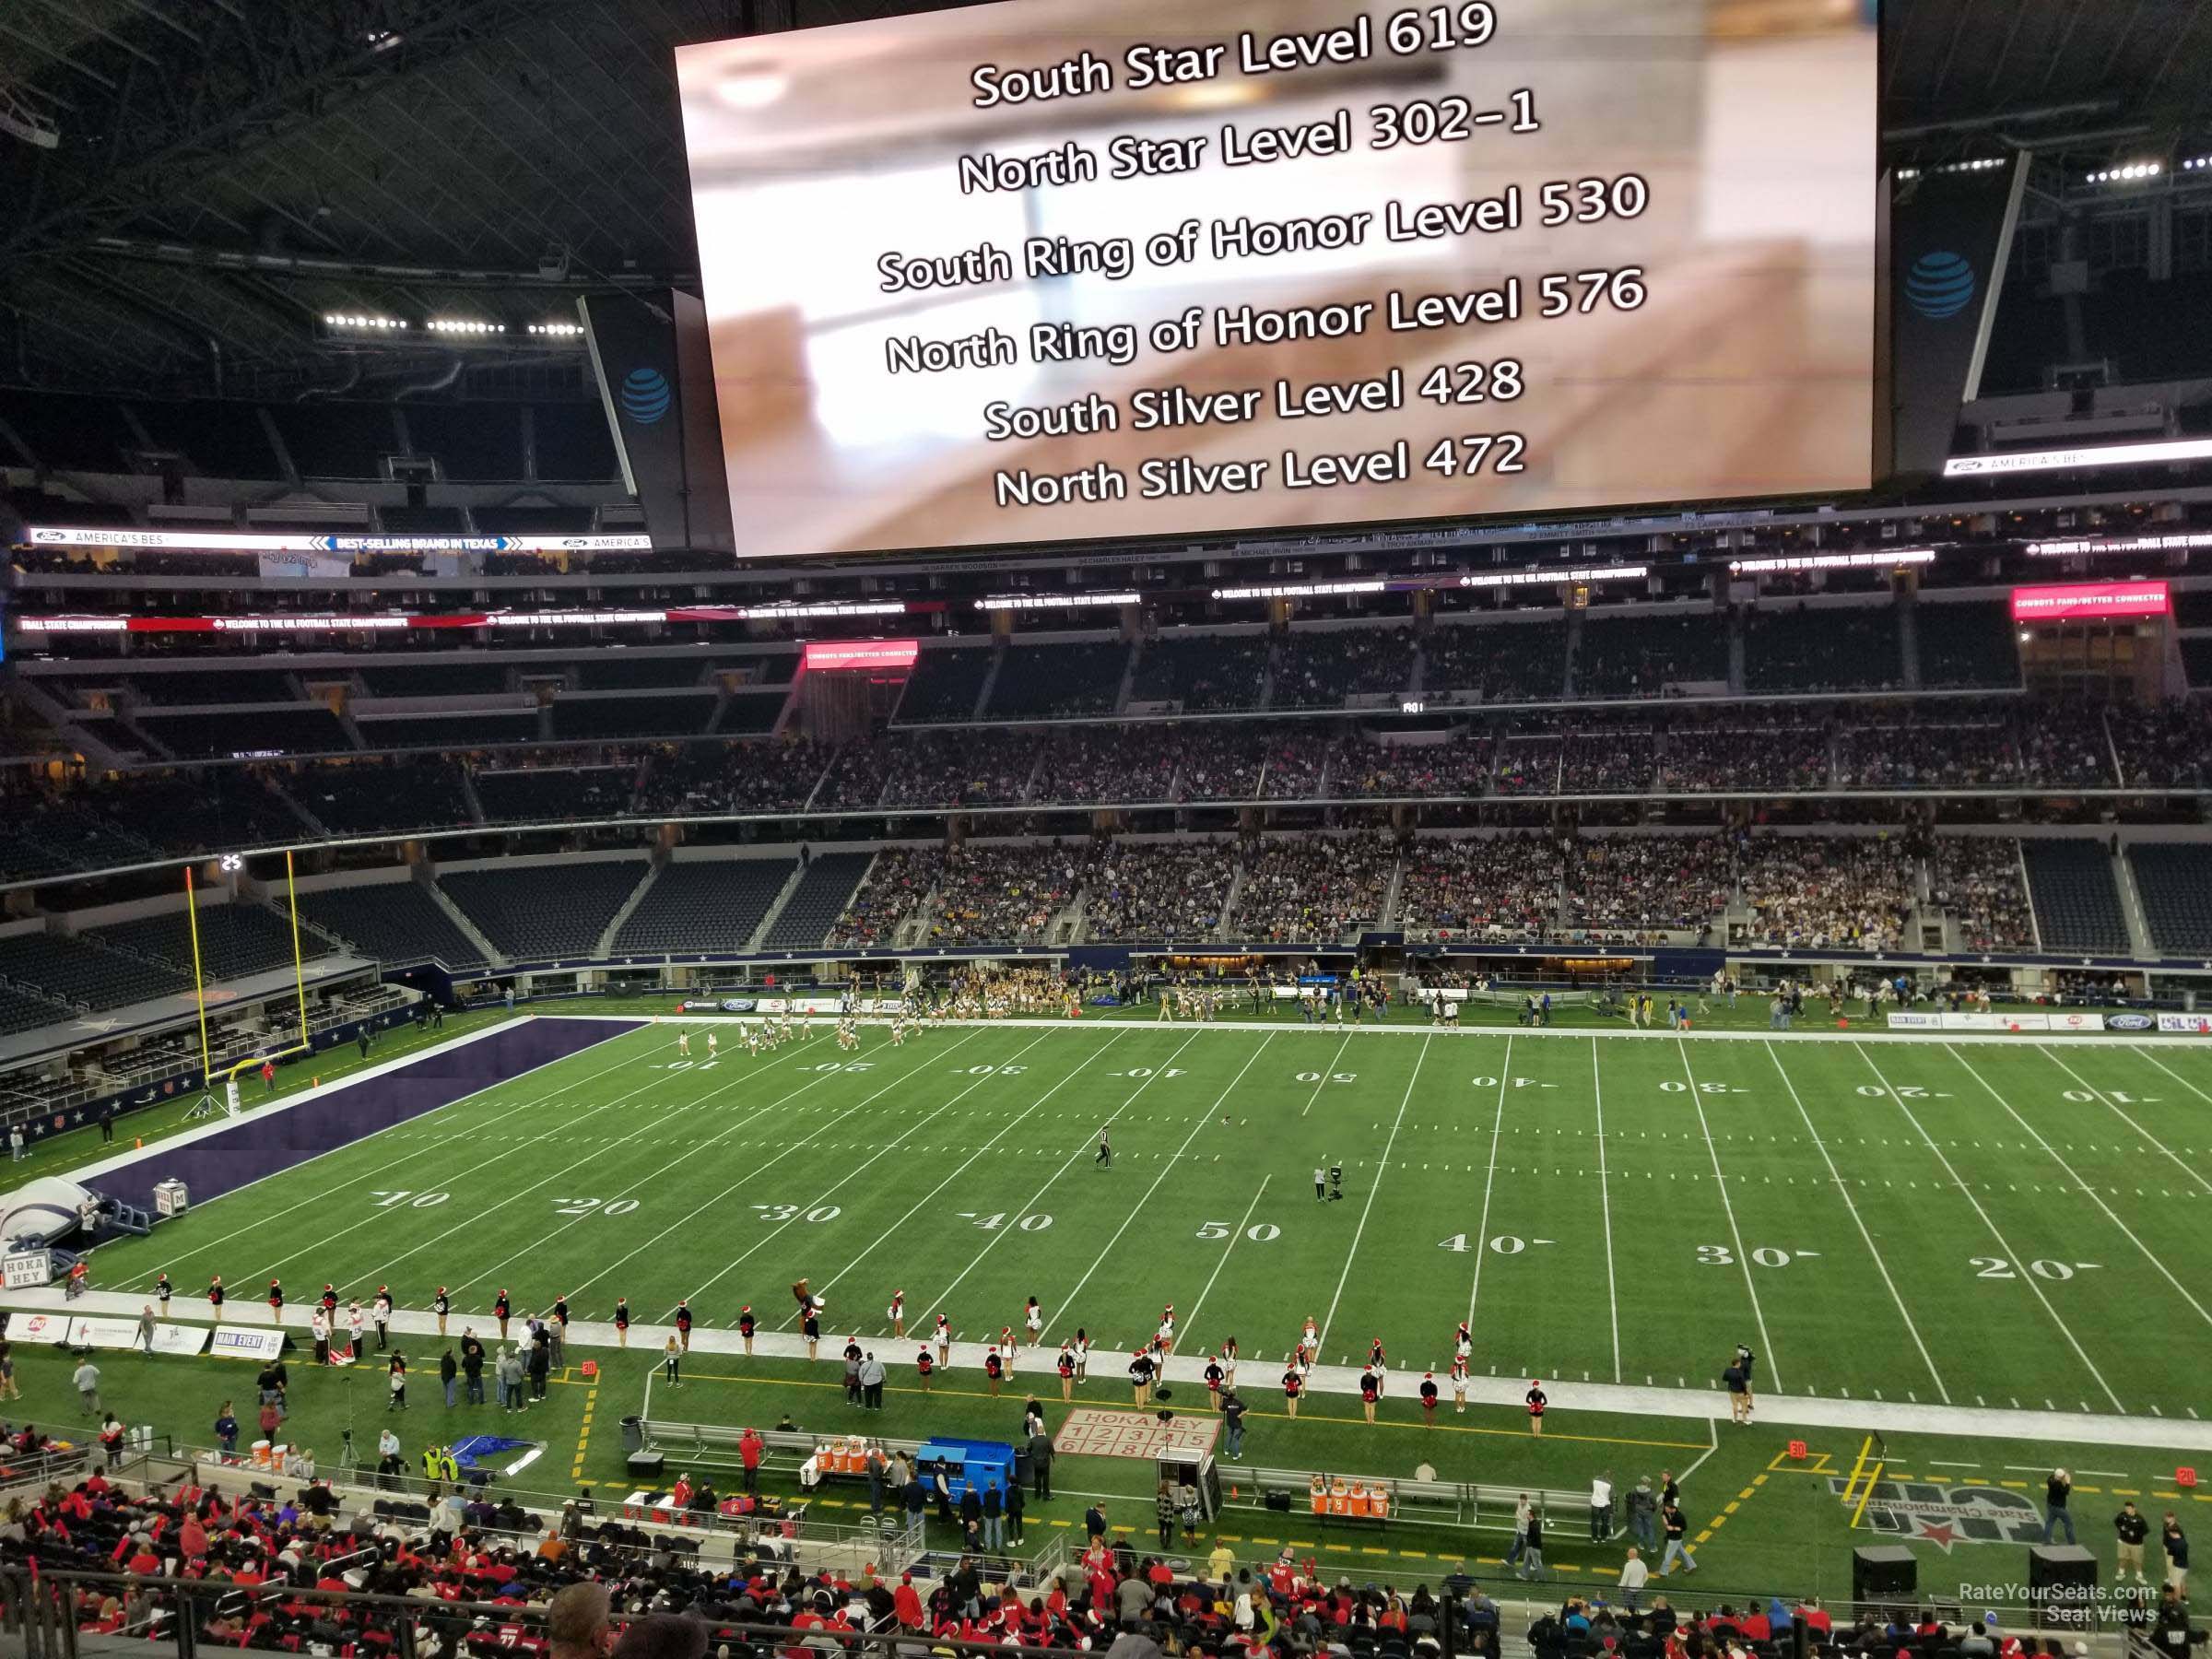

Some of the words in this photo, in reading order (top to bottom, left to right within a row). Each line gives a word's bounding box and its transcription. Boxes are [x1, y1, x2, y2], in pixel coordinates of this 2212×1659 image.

[971, 50, 1113, 108] South
[1124, 43, 1225, 88] Star
[1240, 15, 1371, 74] Level
[1385, 2, 1496, 54] 619
[959, 142, 1097, 194] North
[1109, 135, 1207, 179] Star
[1221, 108, 1351, 166] Level
[1370, 88, 1540, 149] 302-1
[877, 242, 1012, 292] South
[1024, 235, 1134, 278] Ring
[1146, 218, 1201, 266] of
[1211, 212, 1371, 258] Honor
[1385, 185, 1522, 241] Level
[1540, 172, 1650, 226] 530
[886, 328, 1017, 374] North
[1030, 323, 1137, 365] Ring
[1149, 307, 1203, 351] of
[1215, 301, 1373, 346] Honor
[1386, 276, 1521, 331] Level
[1539, 266, 1647, 318] 576
[984, 393, 1119, 441] South
[1131, 386, 1262, 429] Silver
[1276, 367, 1404, 418] Level
[1419, 359, 1524, 405] 428
[995, 462, 1127, 507] North
[1139, 456, 1268, 499] Silver
[1283, 440, 1409, 488] Level
[1426, 432, 1526, 477] 472
[76, 532, 137, 543] AMERICA'S
[336, 538, 411, 549] BEST-SELLING
[412, 538, 450, 549] BRAND
[462, 538, 499, 549] TEXAS
[1472, 575, 1502, 585] WELCOME
[1537, 571, 1569, 582] FOOTBALL
[1222, 589, 1251, 598] WELCOME
[1283, 585, 1313, 595] FOOTBALL
[1314, 585, 1332, 594] STATE
[984, 599, 1013, 608] WELCOME
[1044, 597, 1073, 606] FOOTBALL
[1074, 596, 1091, 606] STATE
[2017, 599, 2054, 607] COWBOYS
[2116, 594, 2165, 603] CONNECTED
[45, 620, 67, 629] STATE
[225, 619, 259, 629] WELCOME
[296, 619, 330, 628] FOOTBALL
[331, 618, 351, 628] STATE
[499, 615, 529, 624] WELCOME
[564, 614, 594, 623] FOOTBALL
[222, 854, 241, 870] 25
[176, 1194, 183, 1204] M
[6, 1259, 44, 1273] HOKA
[13, 1272, 40, 1284] HEY
[217, 1334, 237, 1345] MAIN
[238, 1335, 263, 1347] EVENT
[1085, 1414, 1148, 1426] HOKA
[1072, 1427, 1082, 1437] 1
[1096, 1429, 1111, 1439] 2
[1129, 1430, 1143, 1441] 3
[1159, 1431, 1174, 1442] 4
[1190, 1434, 1204, 1445] 5
[1061, 1441, 1075, 1451] 6
[1091, 1442, 1105, 1453] 7
[1122, 1444, 1136, 1455] 8
[1988, 1510, 2038, 1522] State
[500, 1635, 516, 1648] 77
